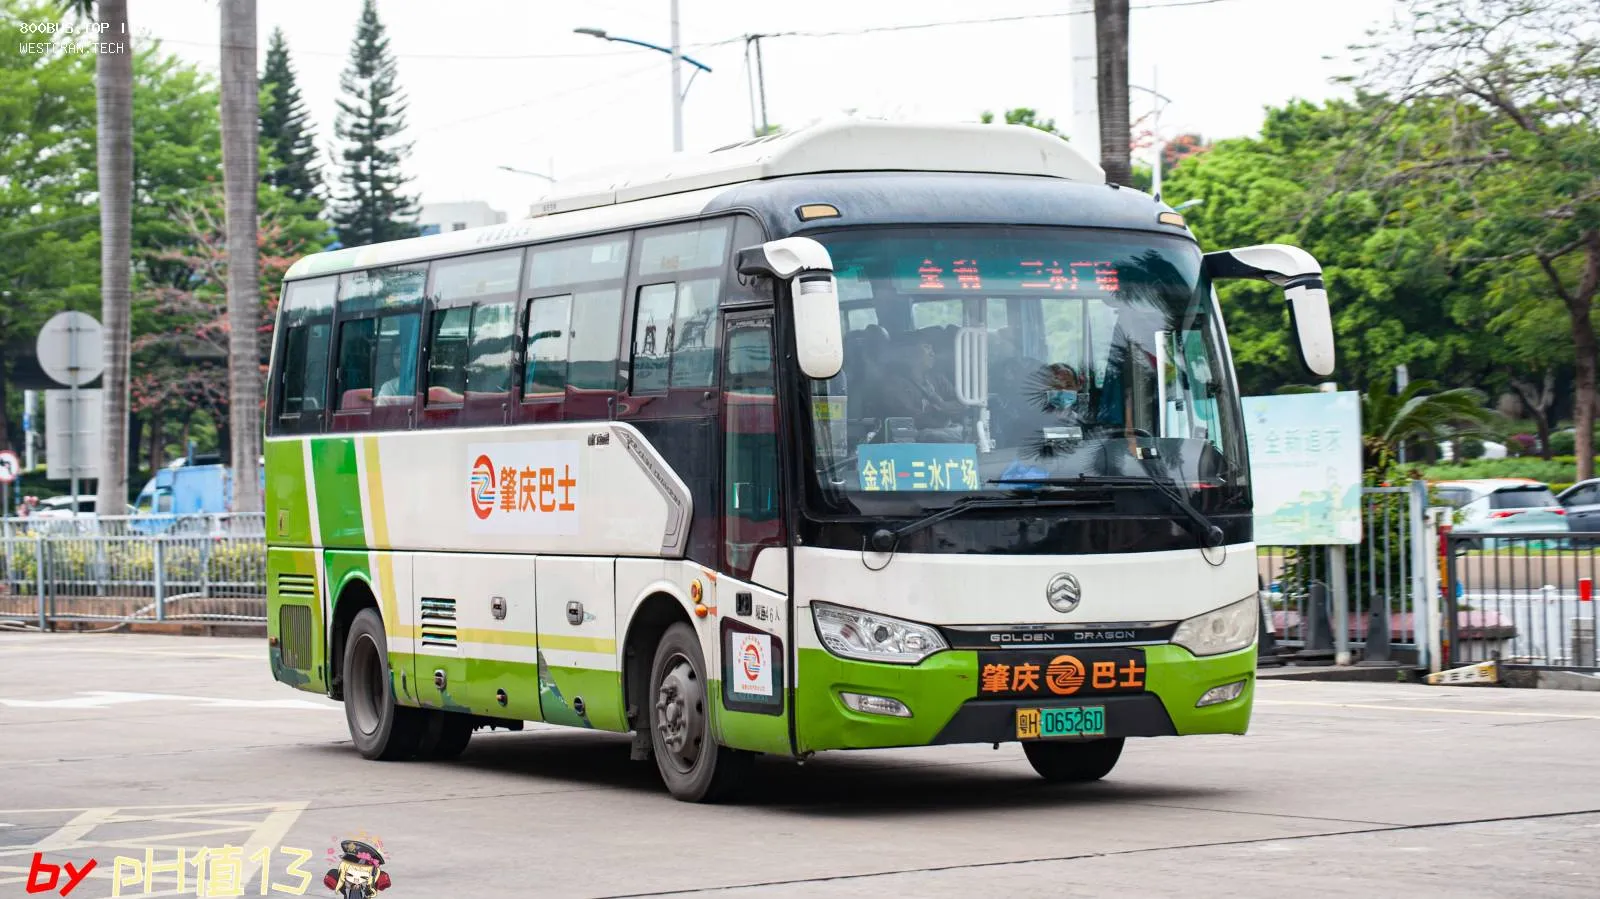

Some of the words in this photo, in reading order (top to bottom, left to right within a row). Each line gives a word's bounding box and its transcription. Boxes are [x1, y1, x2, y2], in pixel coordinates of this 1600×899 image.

[500, 464, 577, 513] 肇庆巴士
[989, 632, 1055, 643] GOLDEN
[1074, 630, 1136, 641] DRAGON
[982, 663, 1041, 693] 肇庆
[1092, 659, 1145, 689] 巴士
